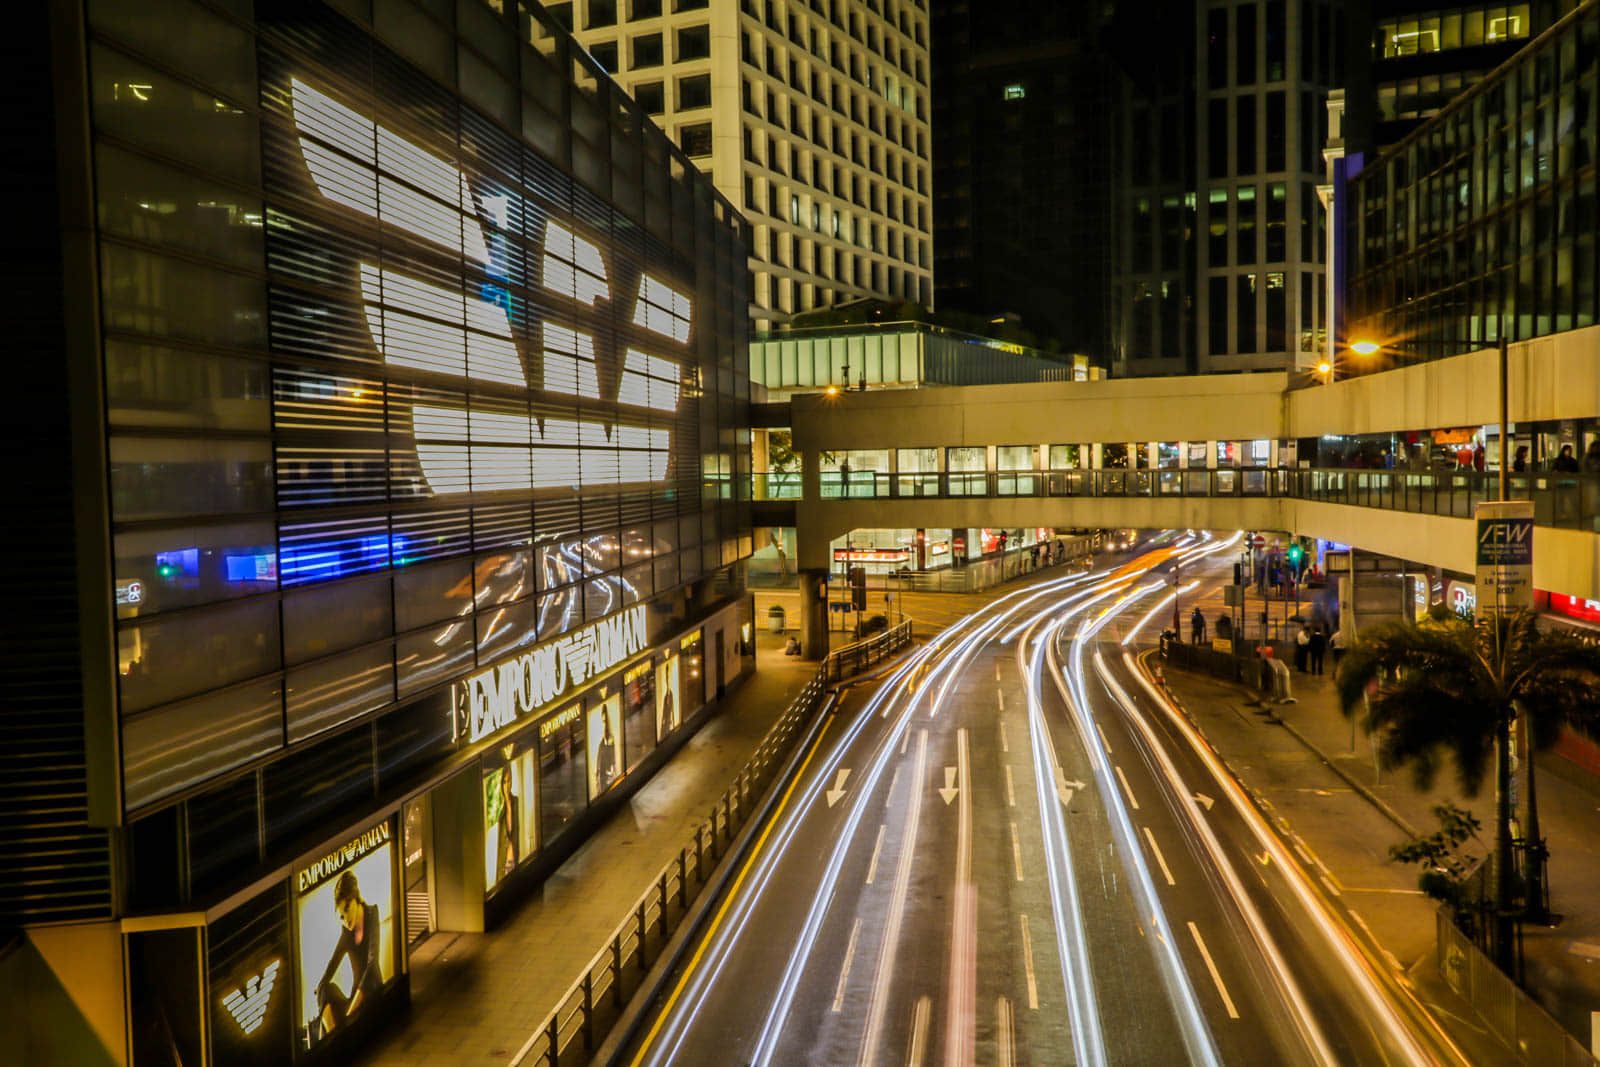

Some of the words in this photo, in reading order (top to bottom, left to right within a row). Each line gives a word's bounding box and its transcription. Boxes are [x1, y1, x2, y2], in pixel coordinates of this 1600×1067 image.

[588, 605, 648, 678] ARMANI
[299, 849, 345, 892] EMPORIO
[355, 821, 390, 857] ARMANI
